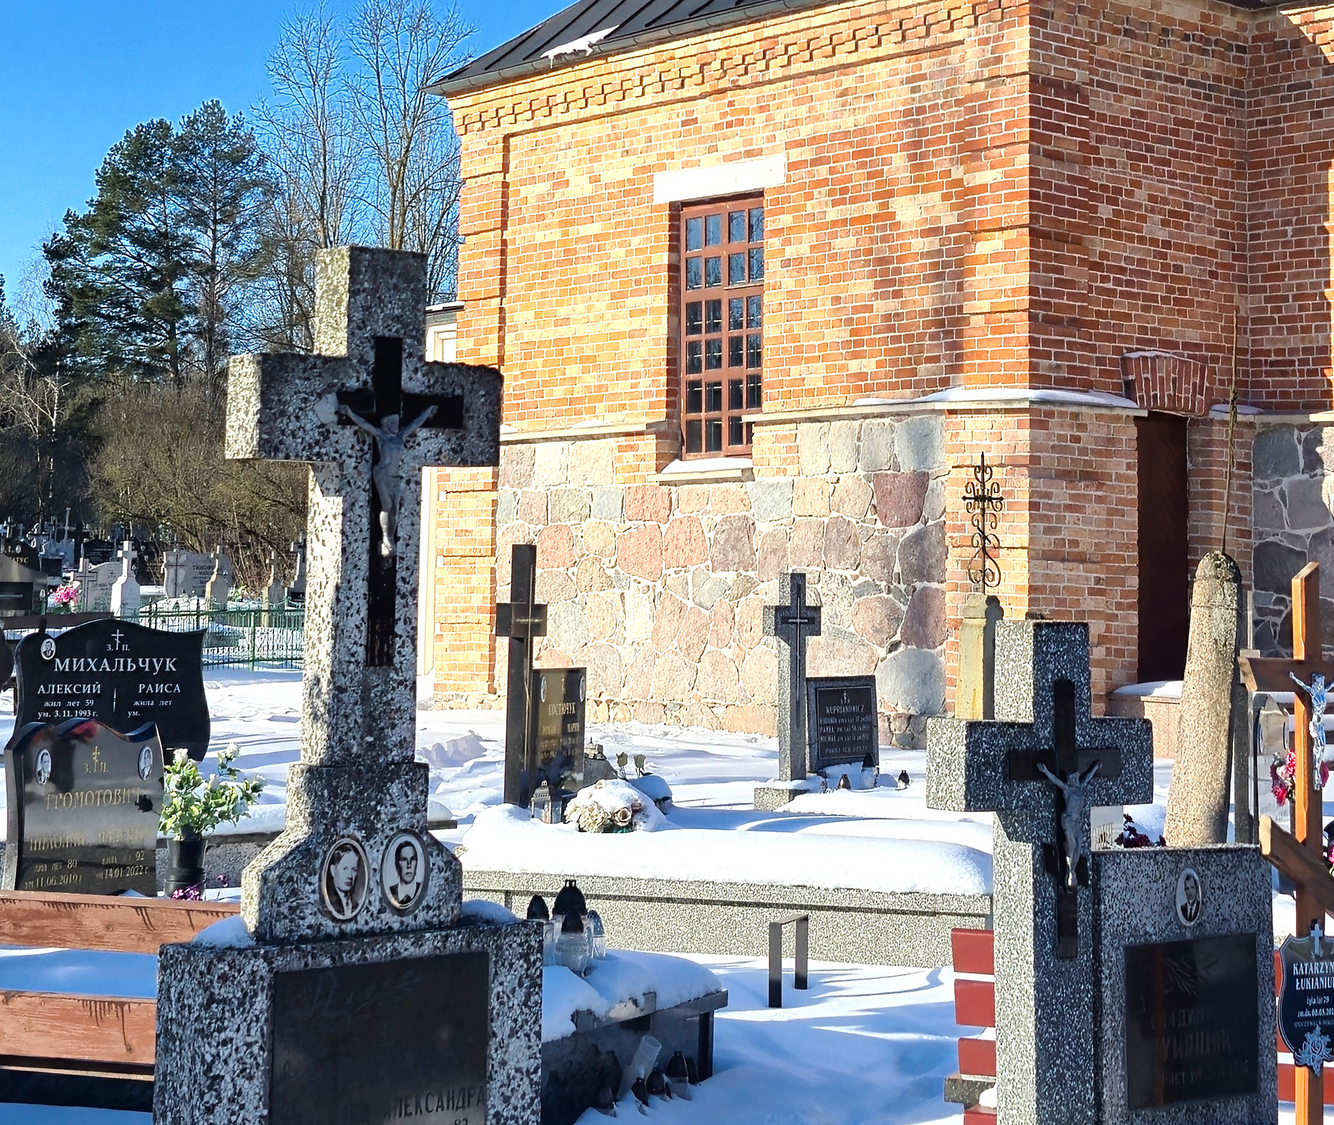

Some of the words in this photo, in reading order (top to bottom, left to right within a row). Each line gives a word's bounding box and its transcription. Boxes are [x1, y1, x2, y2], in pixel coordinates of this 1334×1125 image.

[122, 643, 131, 652] П.
[54, 657, 177, 675] МИХАЛЬЧУК
[37, 681, 102, 695] АЛЕКСИЙ
[138, 683, 181, 694] РАИСА
[85, 699, 95, 707] 59
[37, 711, 52, 720] ум.
[127, 709, 141, 718] ум.
[135, 850, 145, 861] 92
[67, 858, 78, 870] 80
